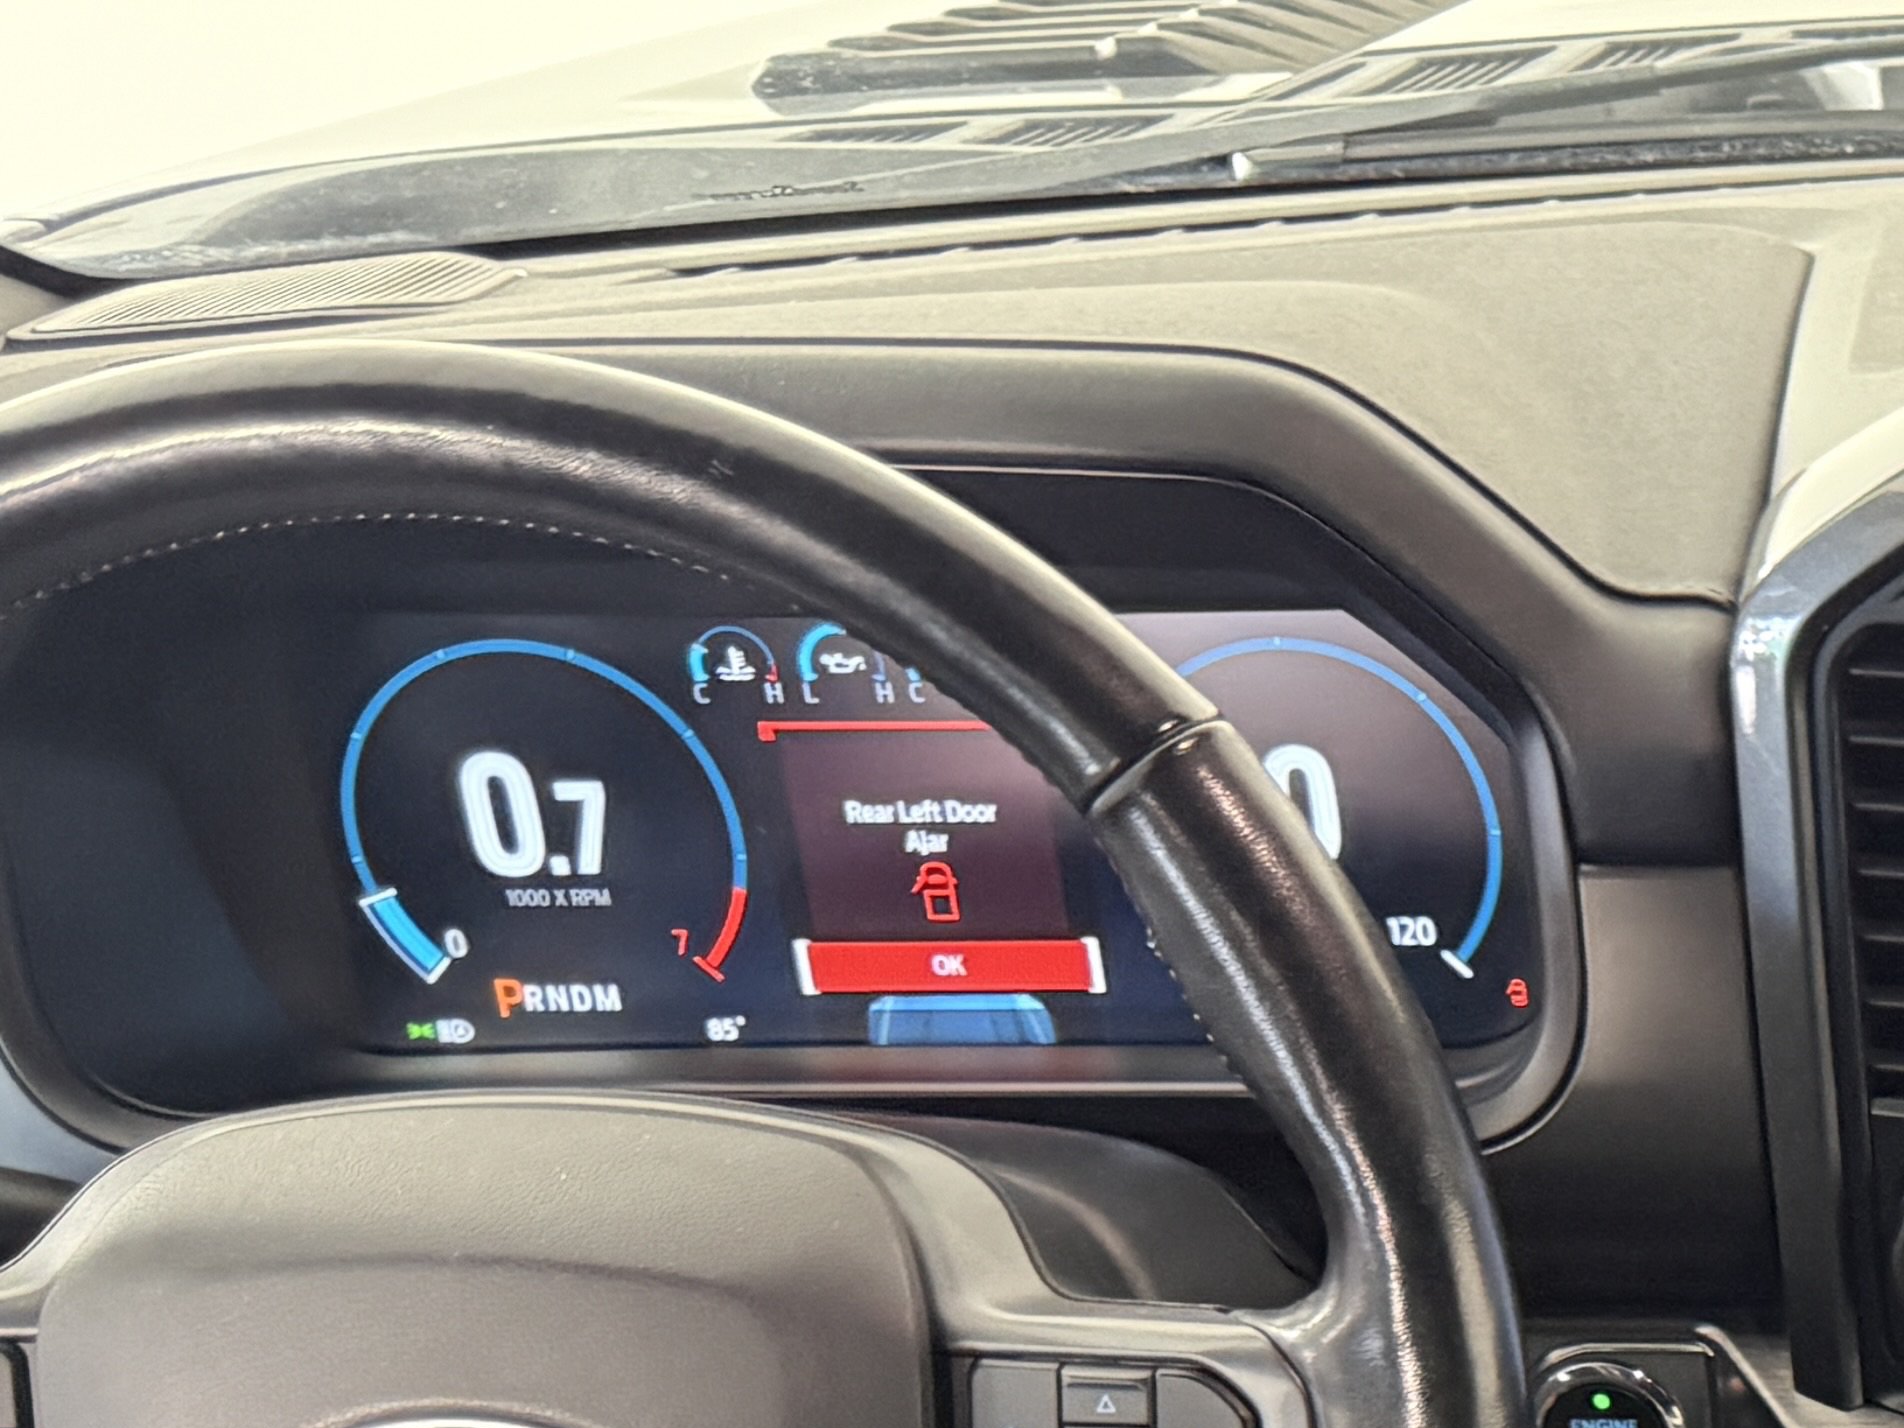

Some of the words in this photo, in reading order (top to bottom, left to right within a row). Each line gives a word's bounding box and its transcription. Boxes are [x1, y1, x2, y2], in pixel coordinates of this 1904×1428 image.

[693, 683, 711, 704] C
[764, 682, 784, 704] H
[803, 682, 820, 704] L
[875, 682, 895, 704] H
[908, 682, 926, 703] C
[459, 749, 606, 879] 0.7
[844, 800, 896, 824] Rear
[897, 800, 943, 824] Left
[945, 800, 997, 824] Door
[905, 830, 949, 855] Ajar
[505, 889, 549, 907] 1000
[571, 889, 612, 907] RPM
[671, 928, 689, 956] 7
[1386, 916, 1437, 946] 120
[443, 927, 469, 959] 0
[931, 954, 968, 975] OK
[706, 1016, 747, 1042] 85°
